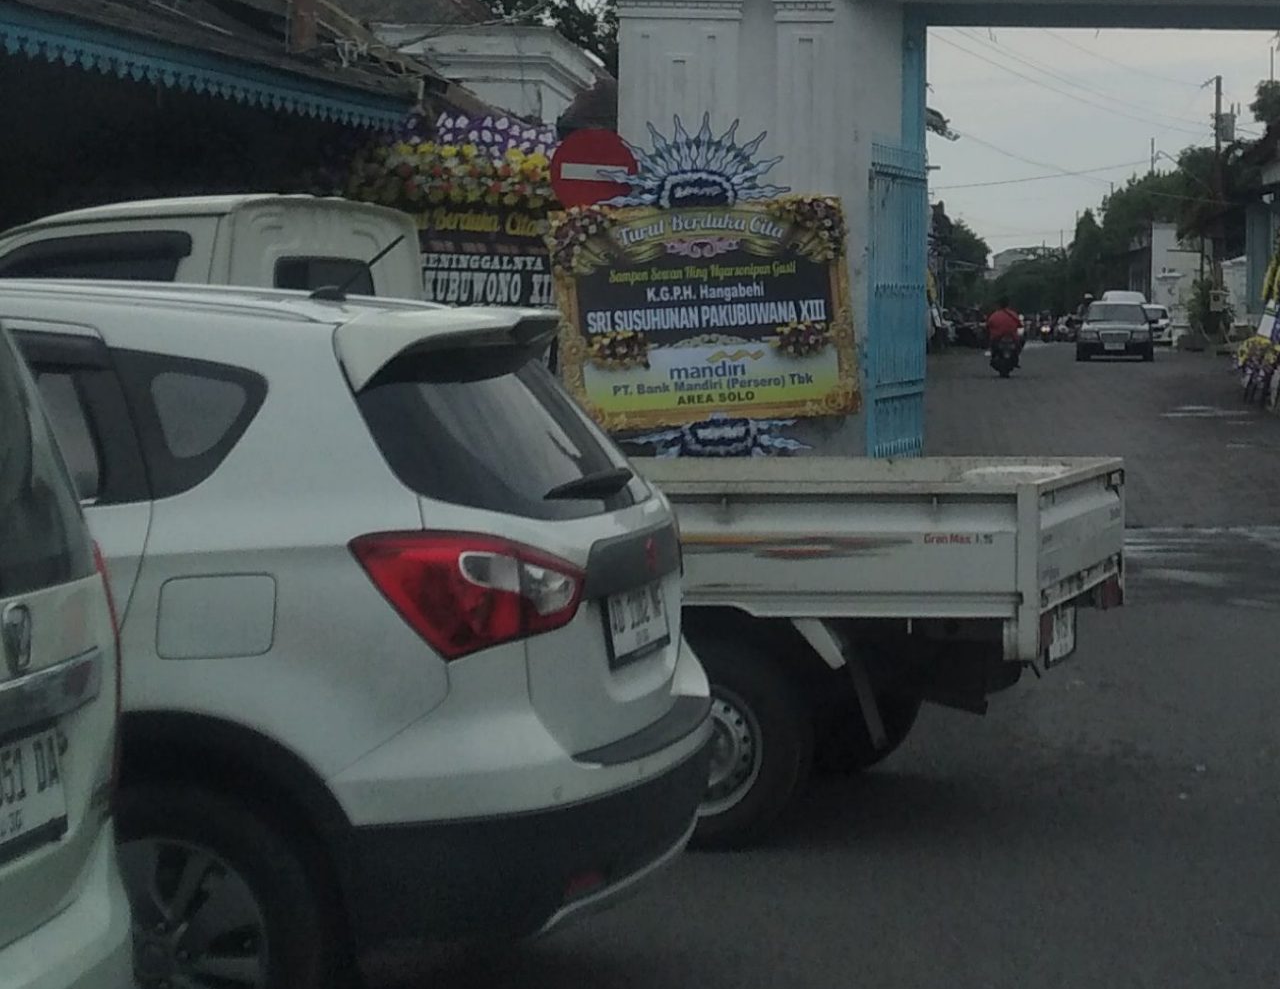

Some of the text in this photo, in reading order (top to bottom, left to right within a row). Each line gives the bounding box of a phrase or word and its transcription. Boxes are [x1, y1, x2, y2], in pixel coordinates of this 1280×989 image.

[671, 212, 746, 235] Berduka
[749, 215, 784, 239] Cita
[646, 281, 765, 303] K.G.P.H. Hangabehi
[587, 299, 826, 333] SRI SUSUHUNAN PAKUBUWANA XIII
[669, 362, 746, 381] mandiri
[637, 382, 670, 394] Bank
[674, 379, 723, 393] Mandiri
[726, 375, 786, 390] (Persero)
[789, 373, 813, 385] Tbk
[677, 391, 755, 405] AREA SOLO
